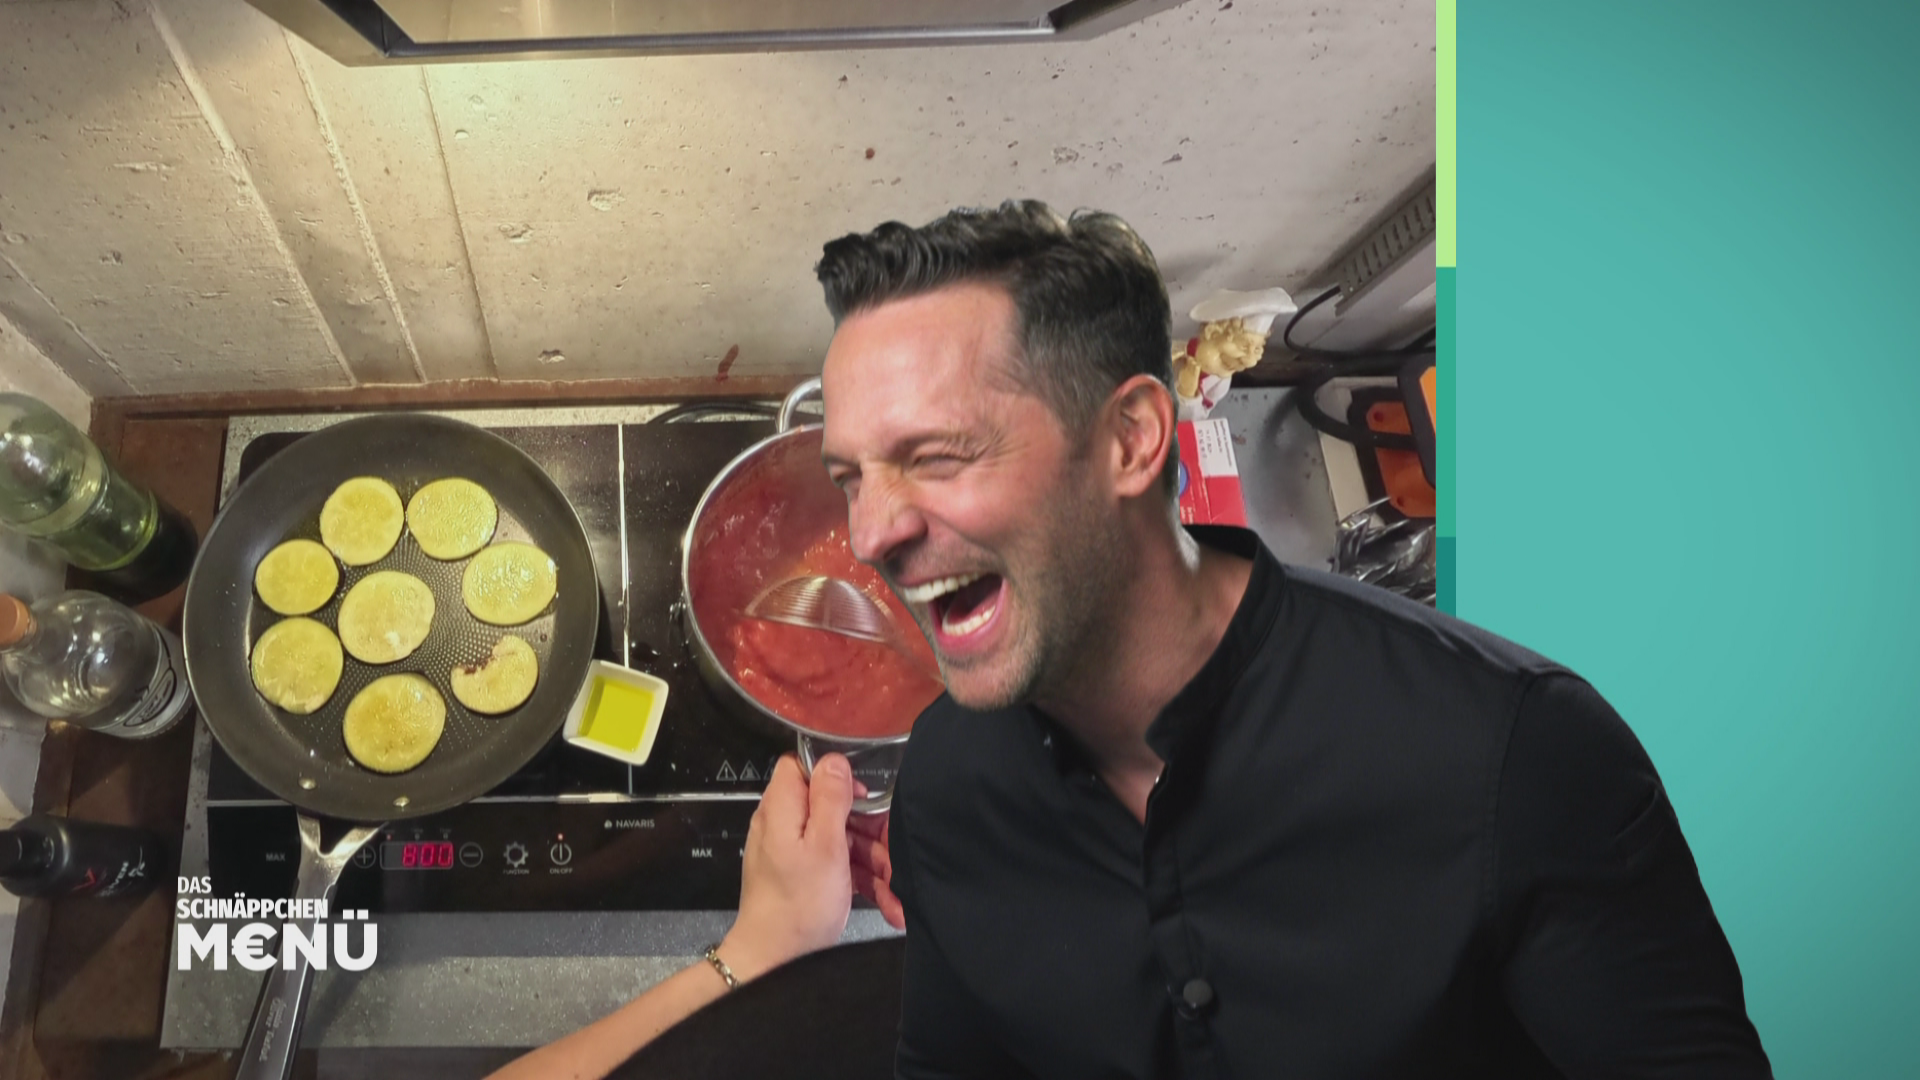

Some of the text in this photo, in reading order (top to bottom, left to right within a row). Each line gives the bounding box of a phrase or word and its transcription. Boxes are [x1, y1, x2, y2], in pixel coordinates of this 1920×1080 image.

[615, 818, 655, 829] NAVARIS
[265, 853, 286, 862] MAX
[402, 842, 453, 867] 800
[691, 848, 713, 858] MAX
